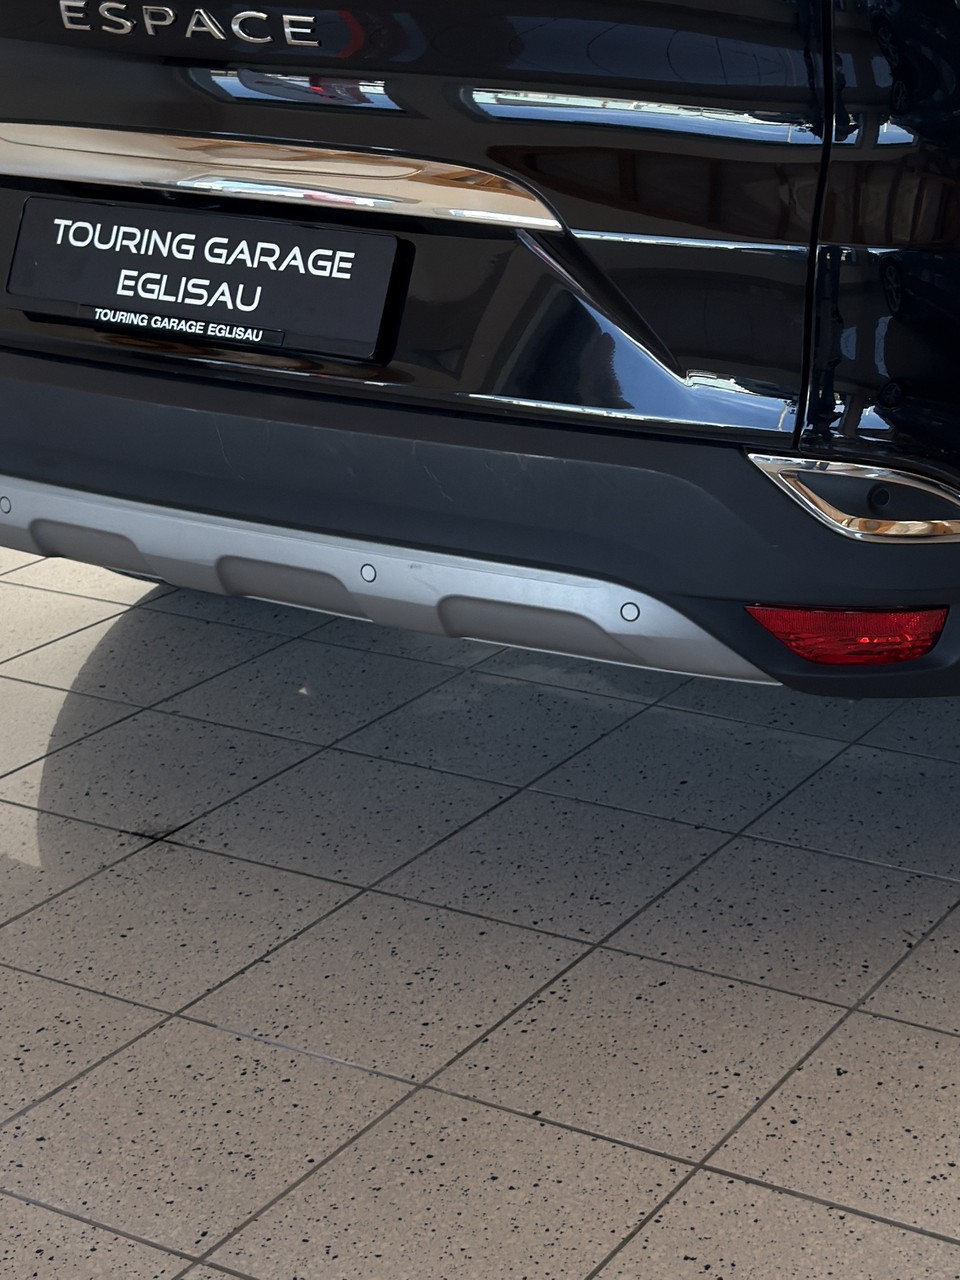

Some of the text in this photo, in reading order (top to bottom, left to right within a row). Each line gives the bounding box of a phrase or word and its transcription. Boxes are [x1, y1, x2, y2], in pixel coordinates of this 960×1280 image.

[53, 218, 356, 279] TOURING GARAGE
[116, 269, 262, 312] EGLISAU
[94, 308, 263, 342] TOURING GARAGE EGLISAU
